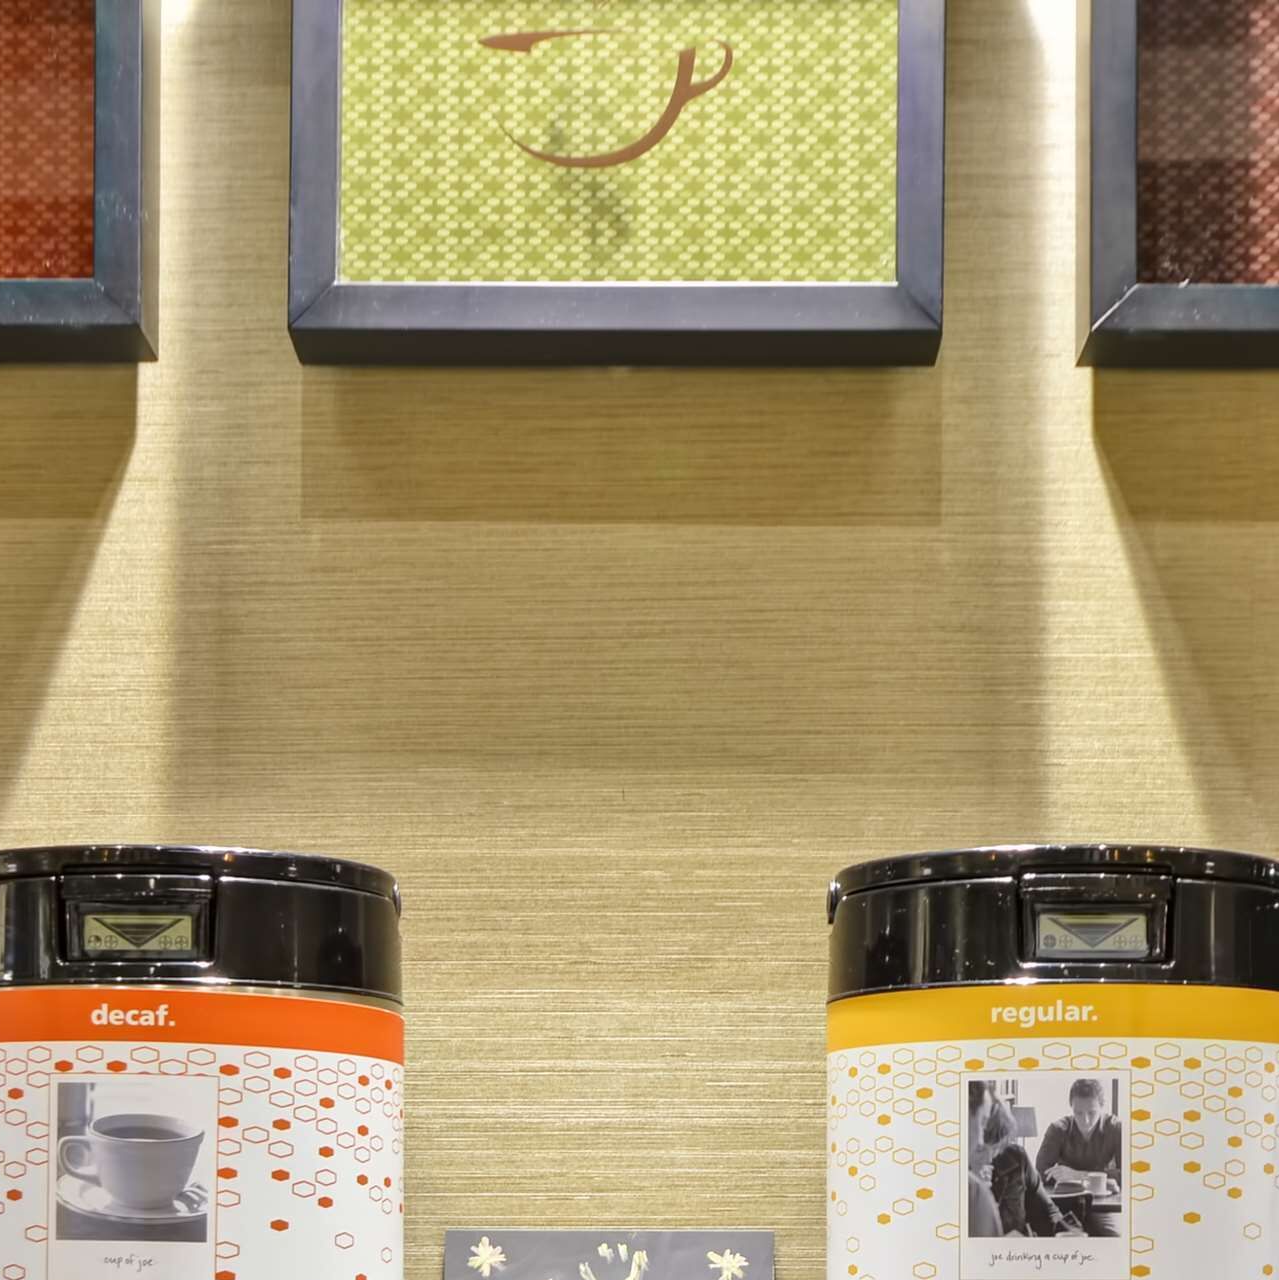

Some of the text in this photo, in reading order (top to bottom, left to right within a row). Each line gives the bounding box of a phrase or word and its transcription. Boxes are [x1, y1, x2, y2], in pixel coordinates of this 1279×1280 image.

[90, 1003, 176, 1027] decaf.
[990, 1000, 1098, 1028] regular.
[104, 1253, 153, 1272] cup of joe
[1006, 1250, 1042, 1270] drinking
[1052, 1253, 1069, 1264] cup
